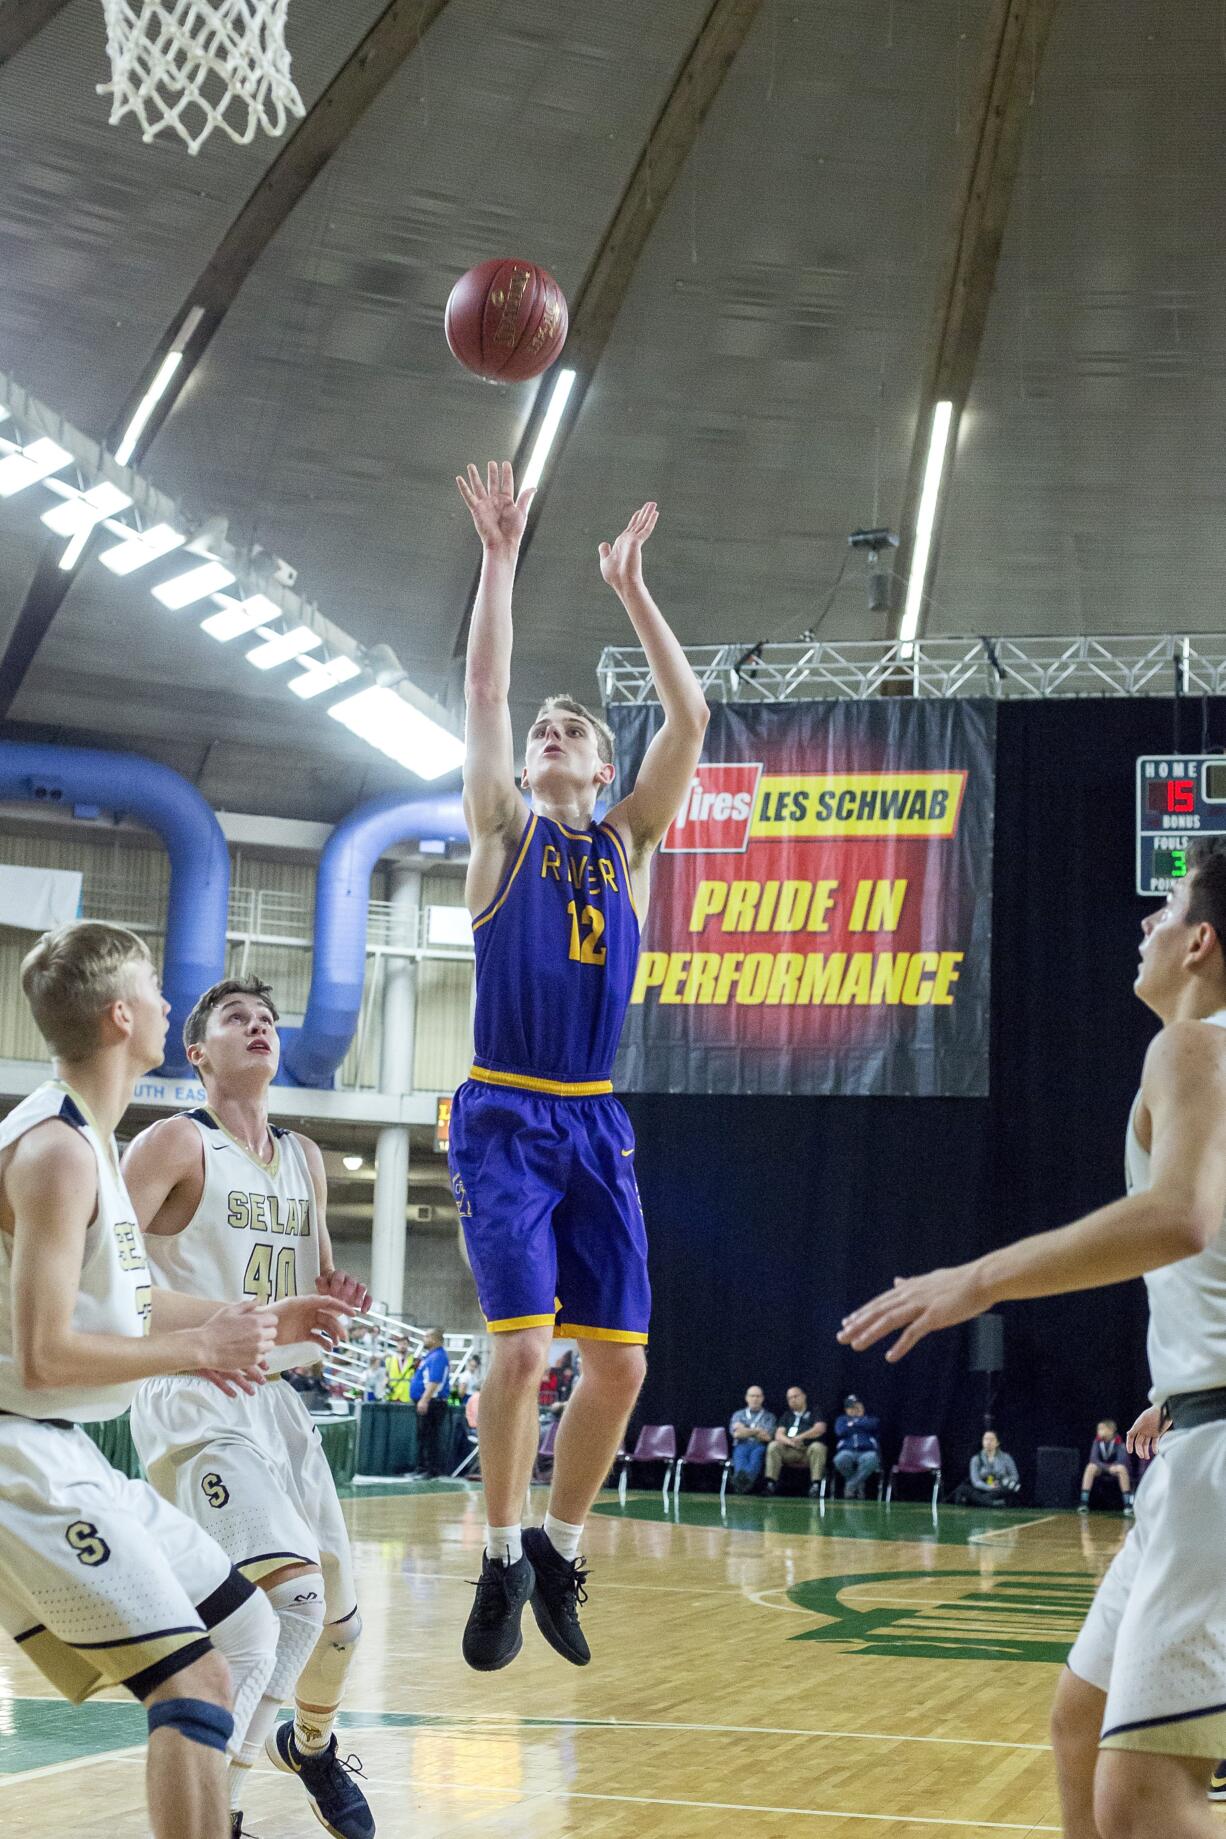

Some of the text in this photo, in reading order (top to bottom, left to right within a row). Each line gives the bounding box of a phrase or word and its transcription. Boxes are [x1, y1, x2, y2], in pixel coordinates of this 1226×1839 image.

[1145, 762, 1197, 778] HOME
[759, 790, 809, 822] LES
[815, 789, 949, 821] SCHWAB
[1167, 780, 1194, 812] 15
[1162, 815, 1200, 829] BONUS
[1153, 836, 1189, 850] FOULS
[1171, 850, 1187, 877] 3
[689, 879, 908, 932] PRIDE IN
[567, 900, 607, 965] 12
[630, 951, 964, 1006] PERFORMANCE
[243, 1243, 298, 1304] 40
[200, 1472, 230, 1509] S
[65, 1520, 111, 1567] S
